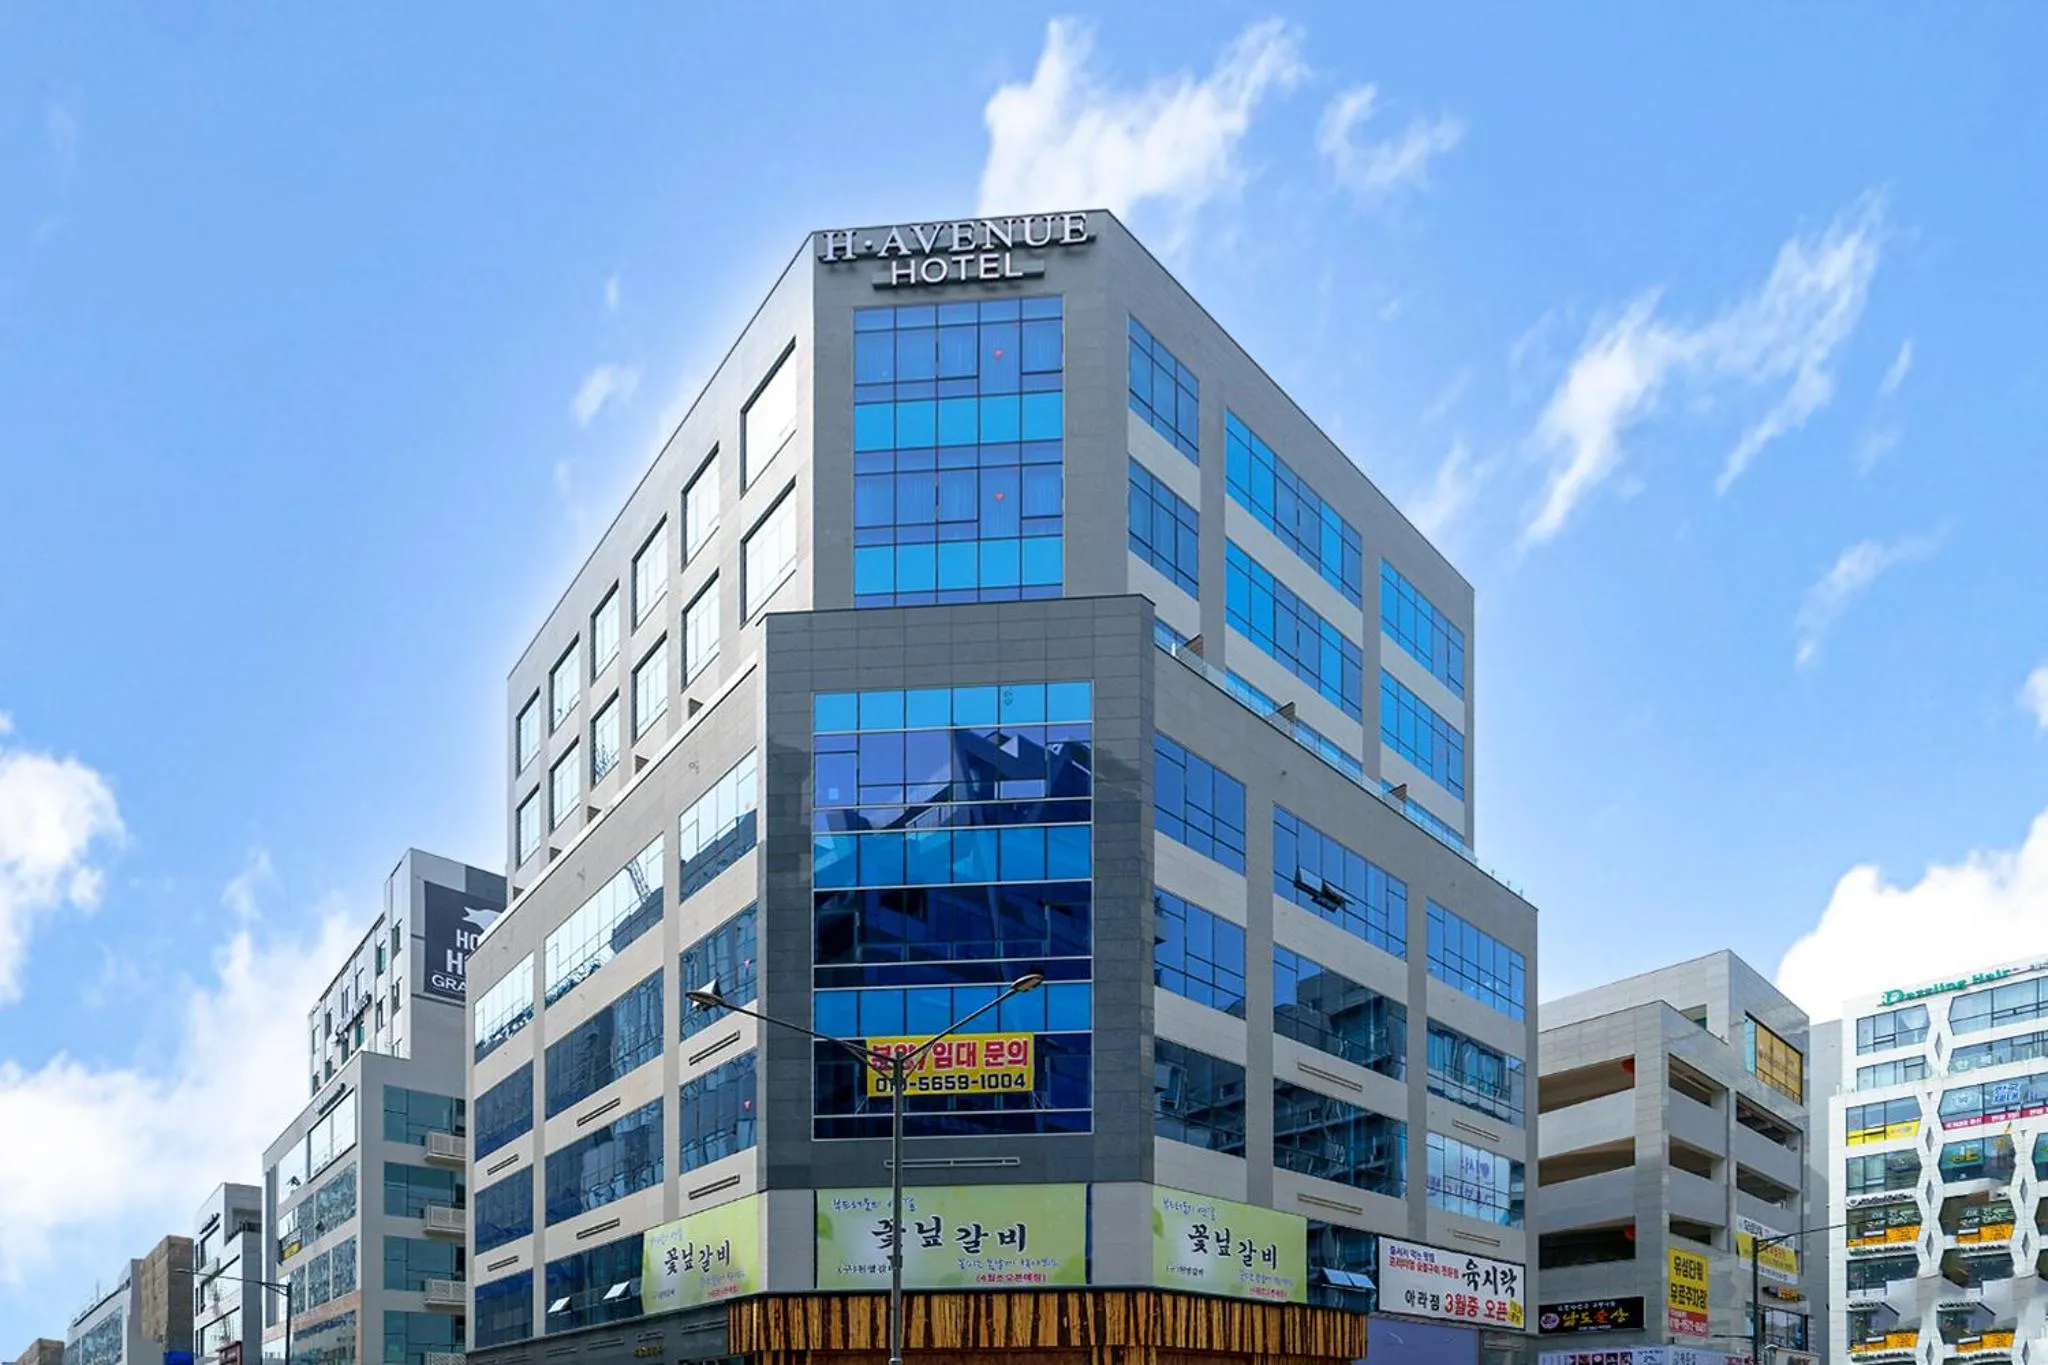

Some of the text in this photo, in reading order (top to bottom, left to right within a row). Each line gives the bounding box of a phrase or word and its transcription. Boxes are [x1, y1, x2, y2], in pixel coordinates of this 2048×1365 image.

[890, 252, 1024, 286] HOTEL
[1882, 977, 1969, 1006] Dazzling
[1971, 967, 2011, 986] Hair
[983, 1040, 1029, 1066] 문의
[1444, 1292, 1480, 1319] 3월중
[1483, 1299, 1508, 1322] 오픈
